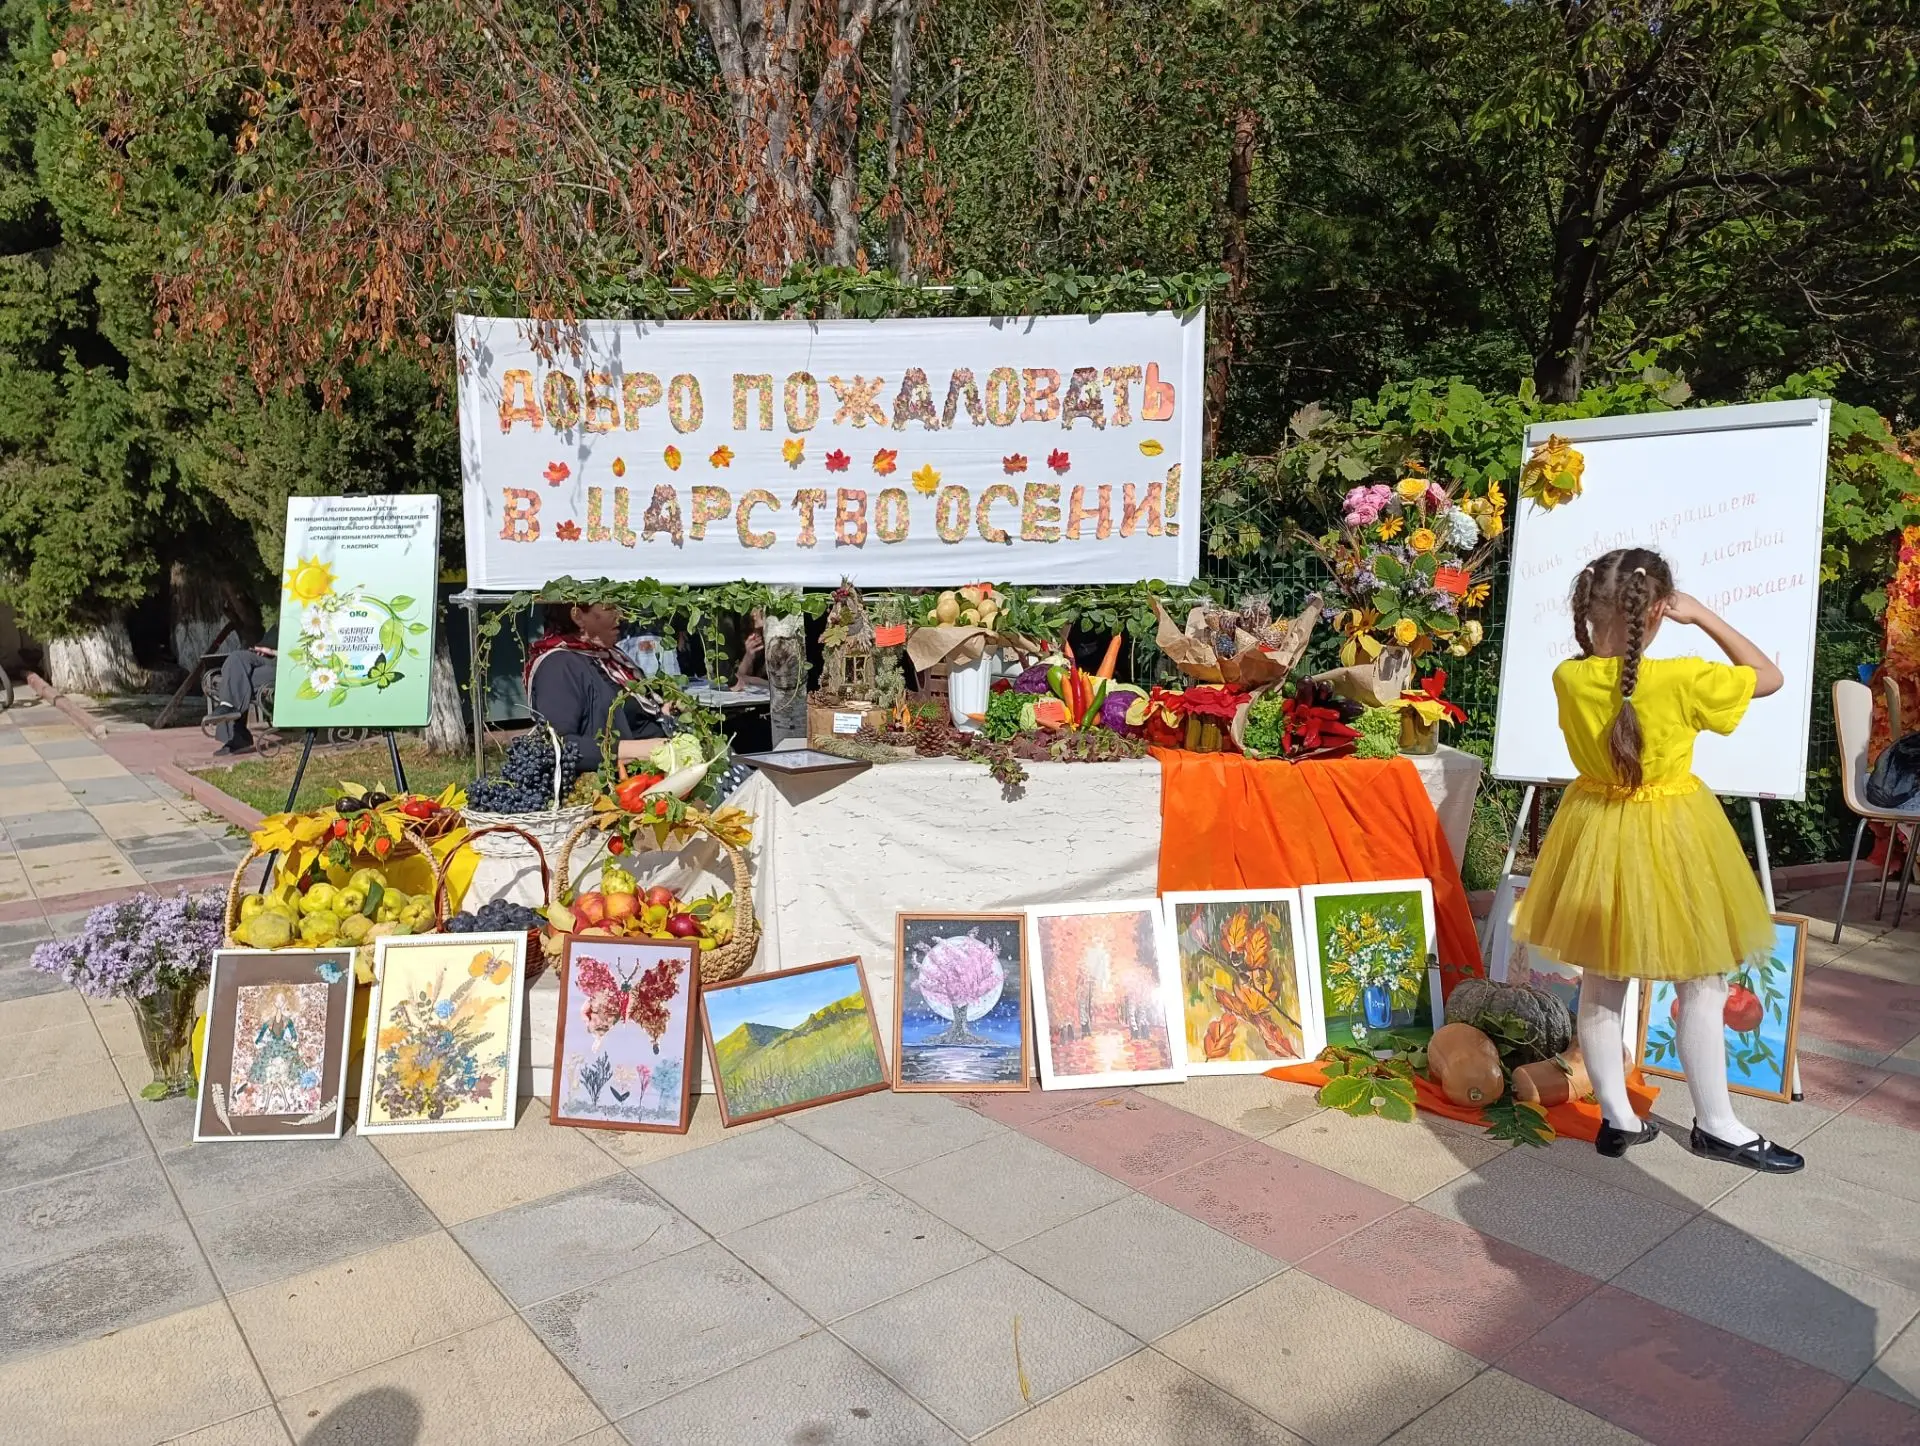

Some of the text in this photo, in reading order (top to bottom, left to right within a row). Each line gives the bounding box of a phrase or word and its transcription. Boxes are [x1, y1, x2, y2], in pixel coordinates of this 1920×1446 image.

[499, 362, 1175, 434] ДОБРО ПОЖАЛОВАТЬ
[500, 463, 1181, 549] В ЦАРСТВО ОСЕНИ!
[1701, 526, 1785, 566] листвой
